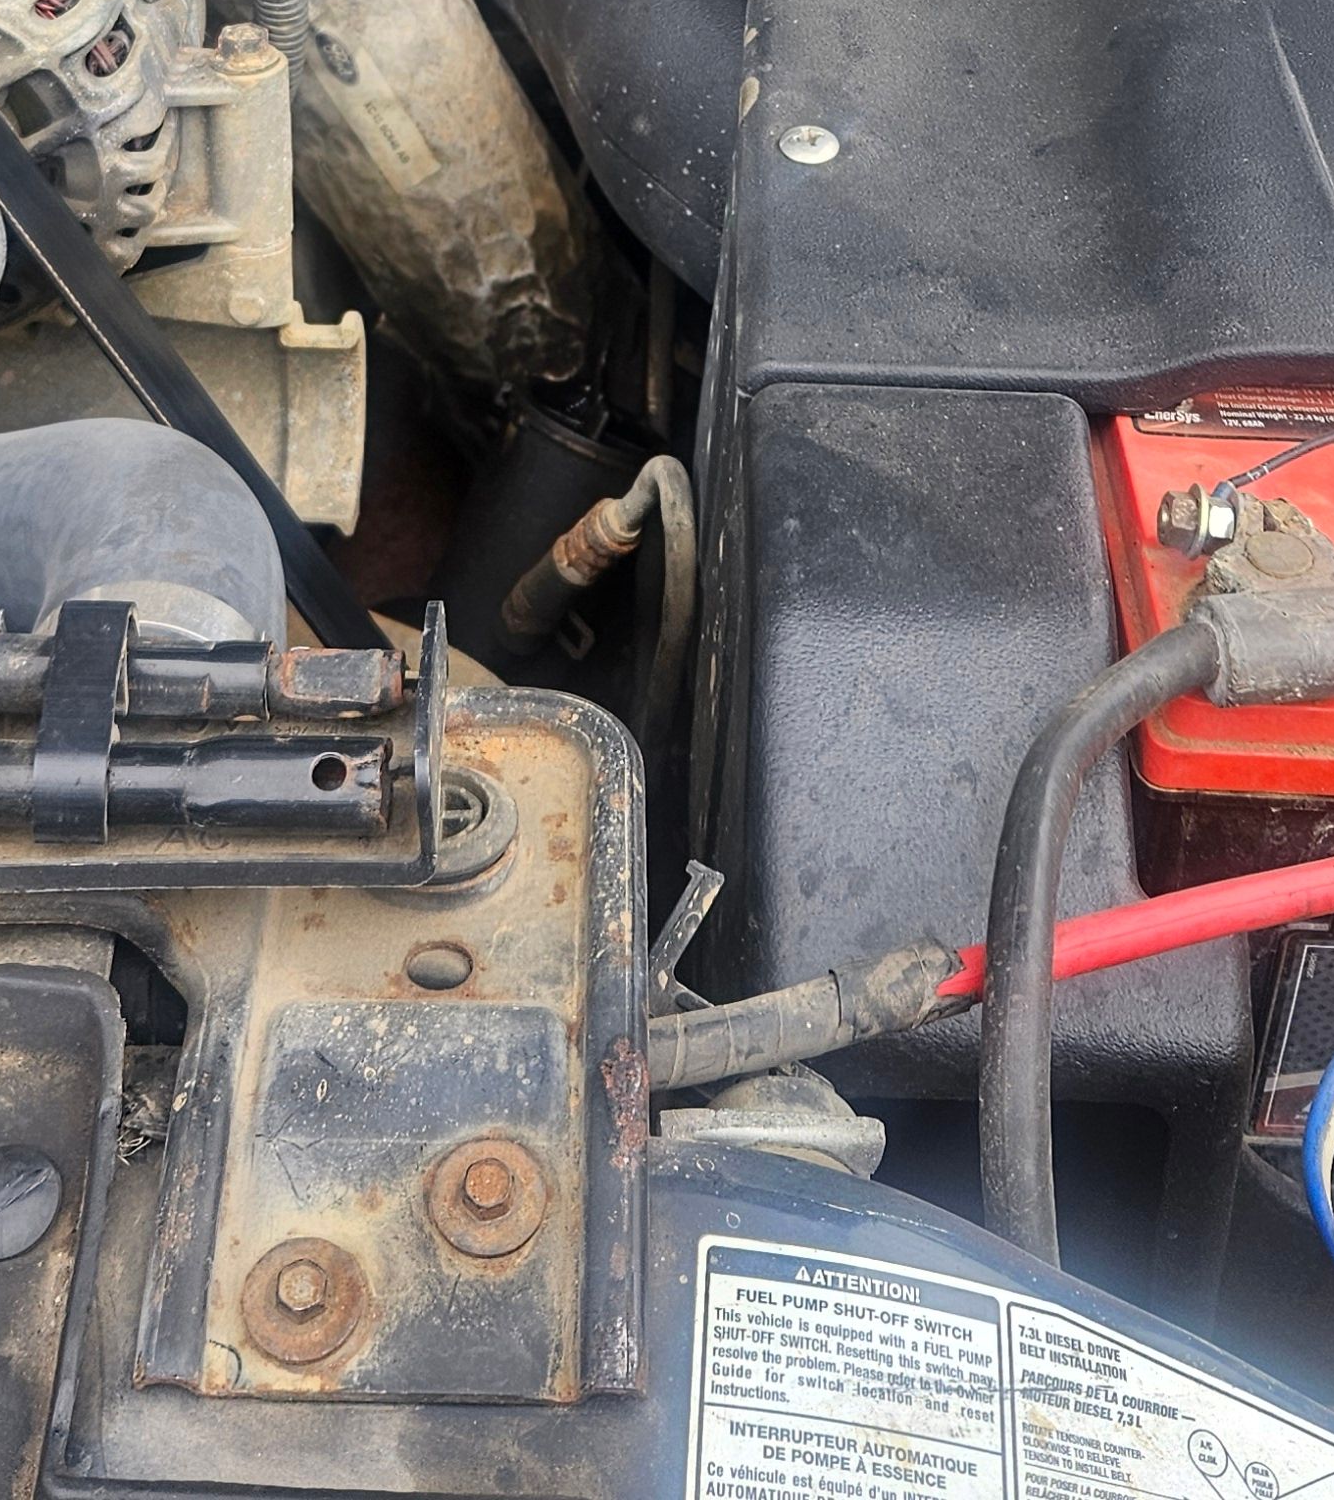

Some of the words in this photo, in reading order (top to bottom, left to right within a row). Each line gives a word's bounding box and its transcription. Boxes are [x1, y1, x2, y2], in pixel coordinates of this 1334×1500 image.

[1219, 410, 1255, 419] Nominal
[1256, 411, 1288, 422] Weight
[1231, 402, 1255, 411] Initial
[1257, 403, 1285, 413] Charge
[811, 1268, 922, 1304] ATTENTION!
[736, 1287, 778, 1306] FUEL
[782, 1293, 830, 1314] PUMP
[833, 1301, 910, 1329] SHUT-OFF
[914, 1318, 974, 1342] SWITCH
[713, 1325, 776, 1347] SHUT-OFF
[780, 1333, 833, 1355] SWITCH.
[836, 1341, 894, 1367] Resetting
[898, 1350, 922, 1370] this
[925, 1360, 965, 1382] switch
[714, 1306, 742, 1324] This
[747, 1312, 793, 1331] vehicle
[798, 1317, 810, 1333] is
[814, 1321, 873, 1344] equipped
[878, 1332, 906, 1350] with
[910, 1339, 919, 1352] a
[923, 1341, 954, 1361] FUEL
[958, 1348, 993, 1368] PUMP
[1017, 1324, 1043, 1343] 7.3L
[1045, 1331, 1086, 1354] DIESEL
[1087, 1341, 1122, 1364] DRIVE
[712, 1346, 759, 1364] resolve
[762, 1349, 783, 1368] the
[785, 1353, 841, 1376] problem.
[843, 1361, 884, 1382] Please
[886, 1371, 916, 1391] refer
[918, 1378, 932, 1393] to
[933, 1380, 954, 1397] the
[1019, 1342, 1047, 1361] BELT
[1049, 1350, 1128, 1383] INSTALLATION
[711, 1361, 753, 1380] Guide
[764, 1366, 786, 1385] for
[797, 1374, 845, 1394] switch
[856, 1382, 914, 1407] location
[923, 1394, 950, 1415] and
[960, 1404, 996, 1425] reset
[1020, 1368, 1084, 1396] PARCOURS
[1085, 1384, 1102, 1401] DE
[1103, 1388, 1119, 1406] LA
[1122, 1394, 1180, 1421] COURROIE
[1021, 1386, 1071, 1412] MOTEUR
[1073, 1399, 1114, 1422] DIESEL
[728, 1420, 859, 1454] INTERRUPTEUR
[861, 1442, 979, 1478] AUTOMATIQUE
[1022, 1435, 1073, 1458] CLOCKWISE
[1073, 1447, 1085, 1460] TO
[1086, 1450, 1122, 1469] RELIEVE
[1023, 1448, 1061, 1468] TENSION
[1062, 1456, 1074, 1471] TO
[1075, 1460, 1110, 1480] INSTALL
[1055, 1429, 1102, 1455] TENSIONER
[1103, 1441, 1146, 1462] COUNTER-
[706, 1461, 725, 1478] Ce
[729, 1463, 787, 1485] véhicule
[791, 1473, 813, 1490] est
[818, 1477, 864, 1499] équipé
[762, 1445, 786, 1461] DE
[791, 1449, 852, 1472] POMPE
[855, 1456, 868, 1475] À
[871, 1463, 948, 1490] ESSENCE
[1024, 1471, 1050, 1488] POUR
[1050, 1477, 1079, 1494] POSER
[1080, 1485, 1092, 1498] LA
